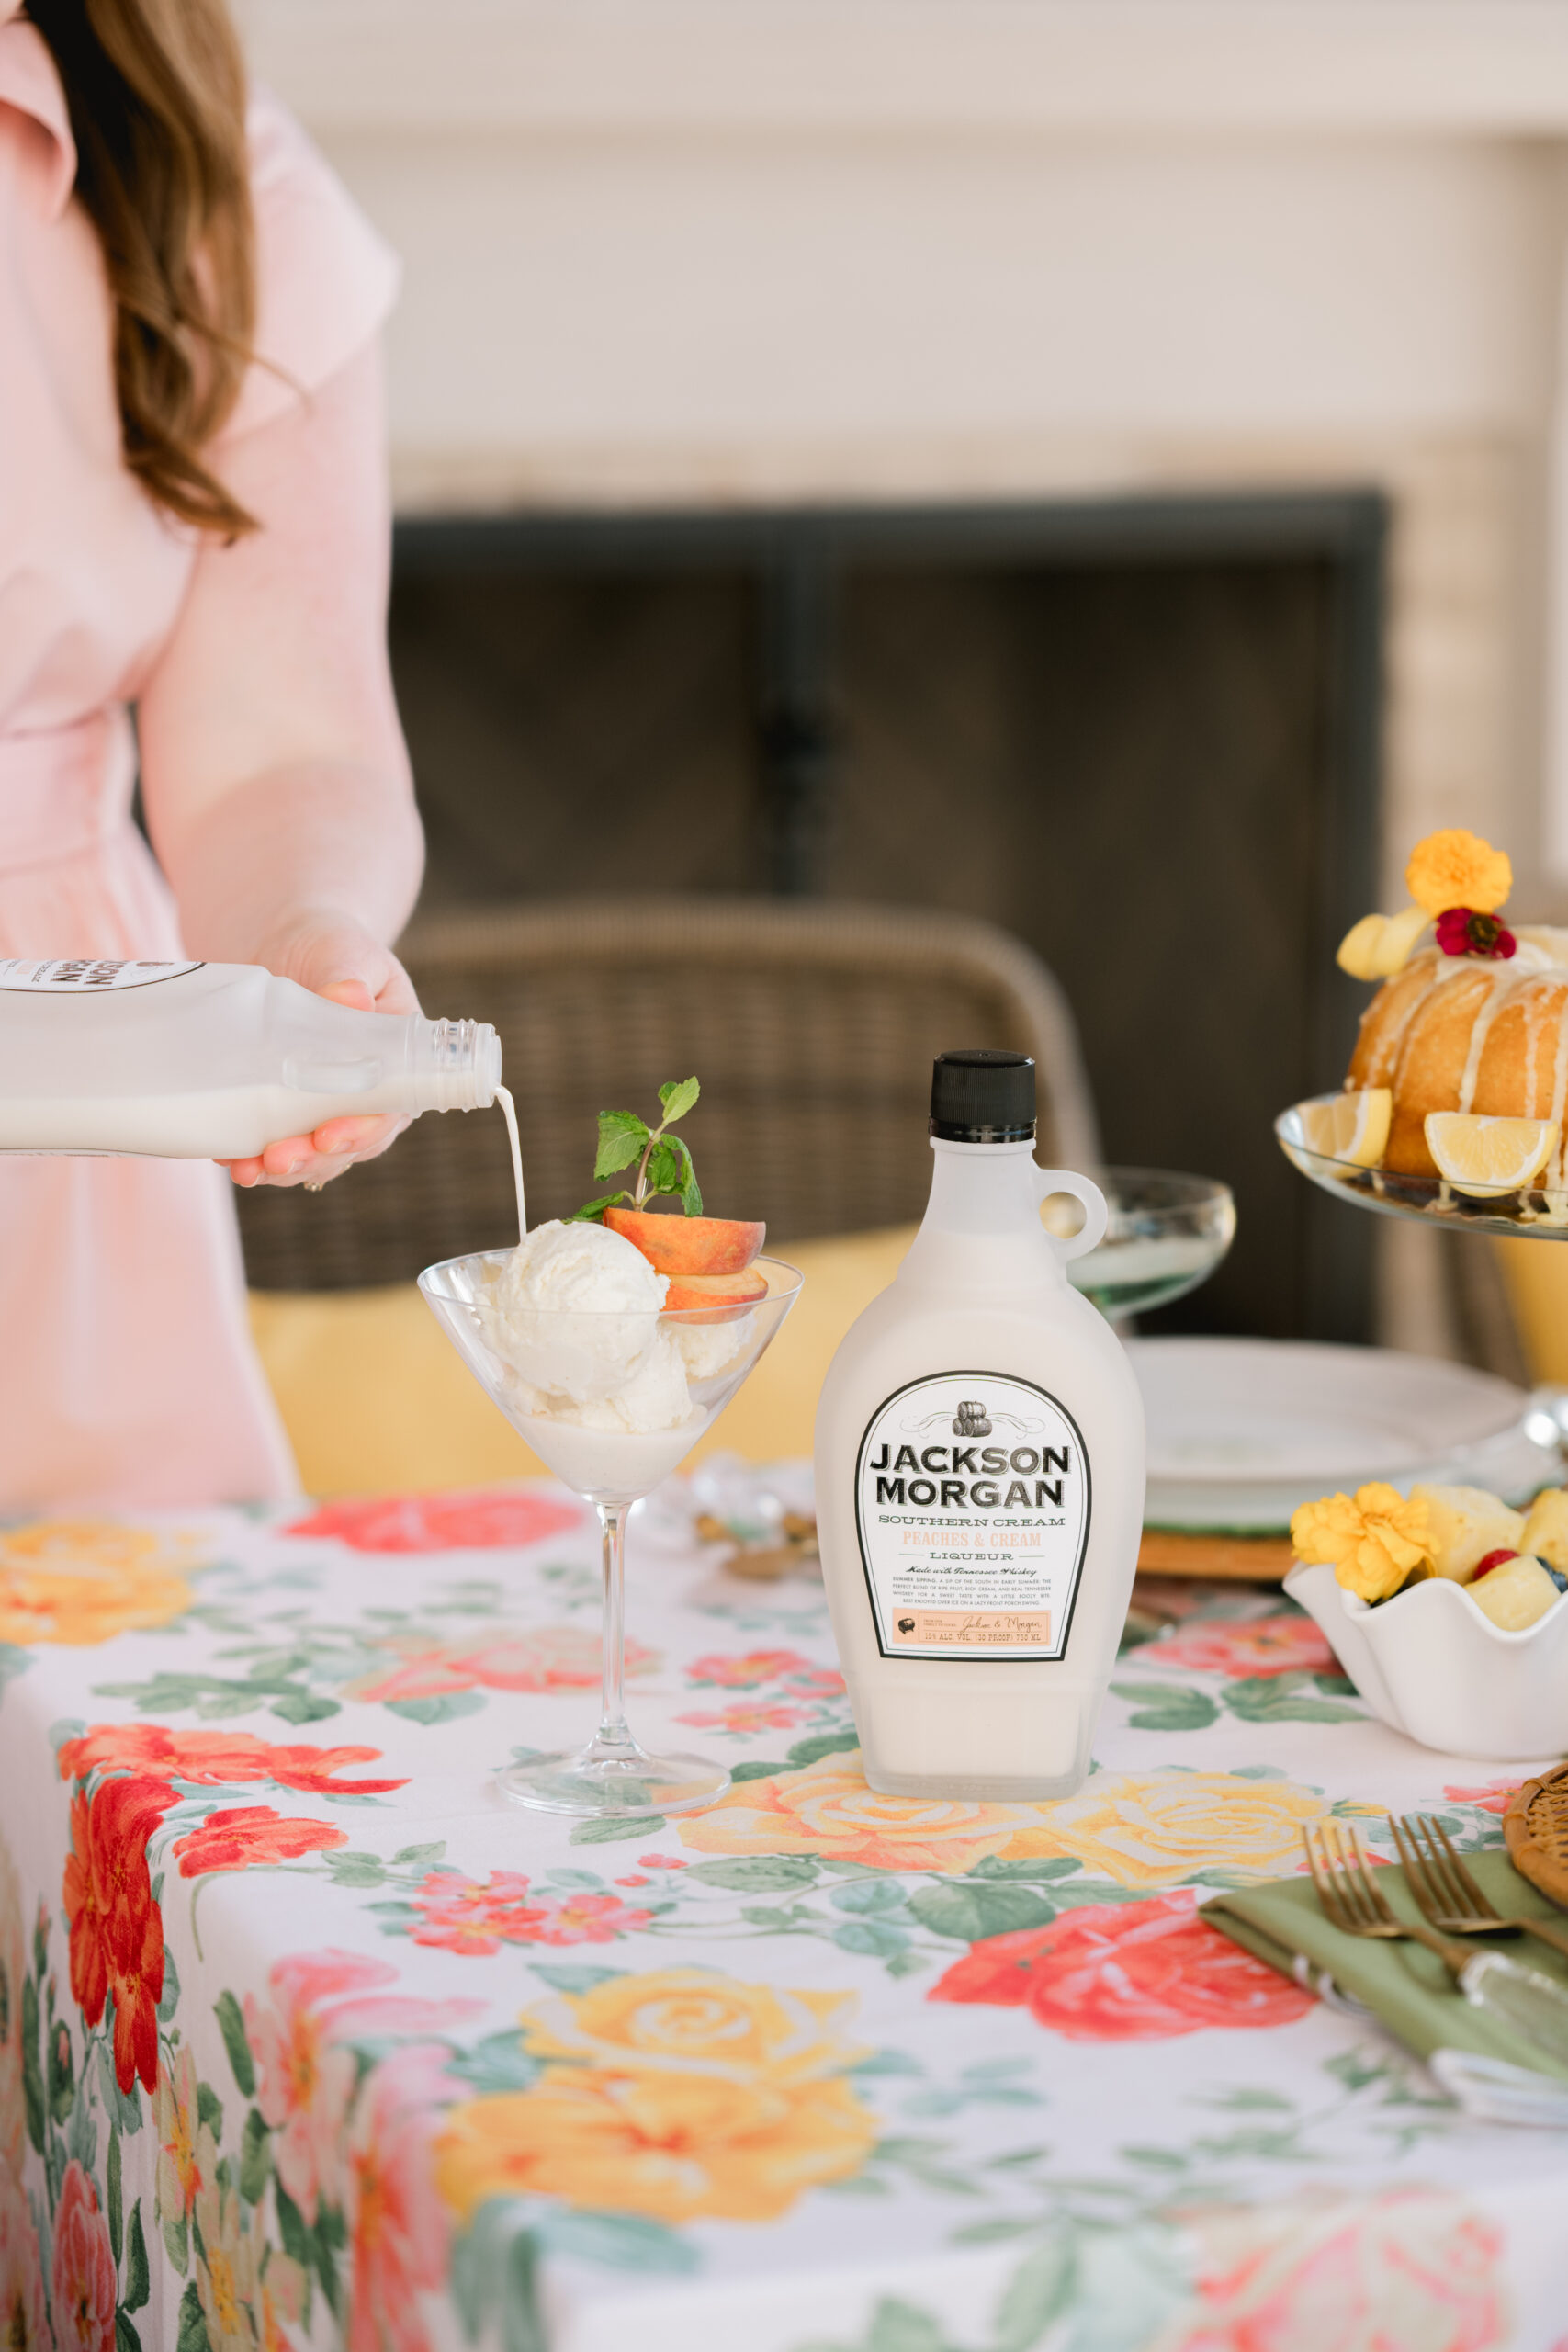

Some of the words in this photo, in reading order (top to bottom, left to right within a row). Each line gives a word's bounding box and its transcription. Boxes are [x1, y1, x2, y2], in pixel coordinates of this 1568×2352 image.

[871, 1443, 1071, 1475] JACKSON
[875, 1477, 1066, 1509] MORGAN
[878, 1515, 988, 1527] SOUTHERN
[993, 1518, 1066, 1527] CREAM
[904, 1531, 969, 1547] PEACHES
[974, 1532, 985, 1547] &
[990, 1532, 1042, 1547] CREAM
[1000, 1567, 1037, 1577] Whiskey
[1004, 1617, 1042, 1633] Morgan
